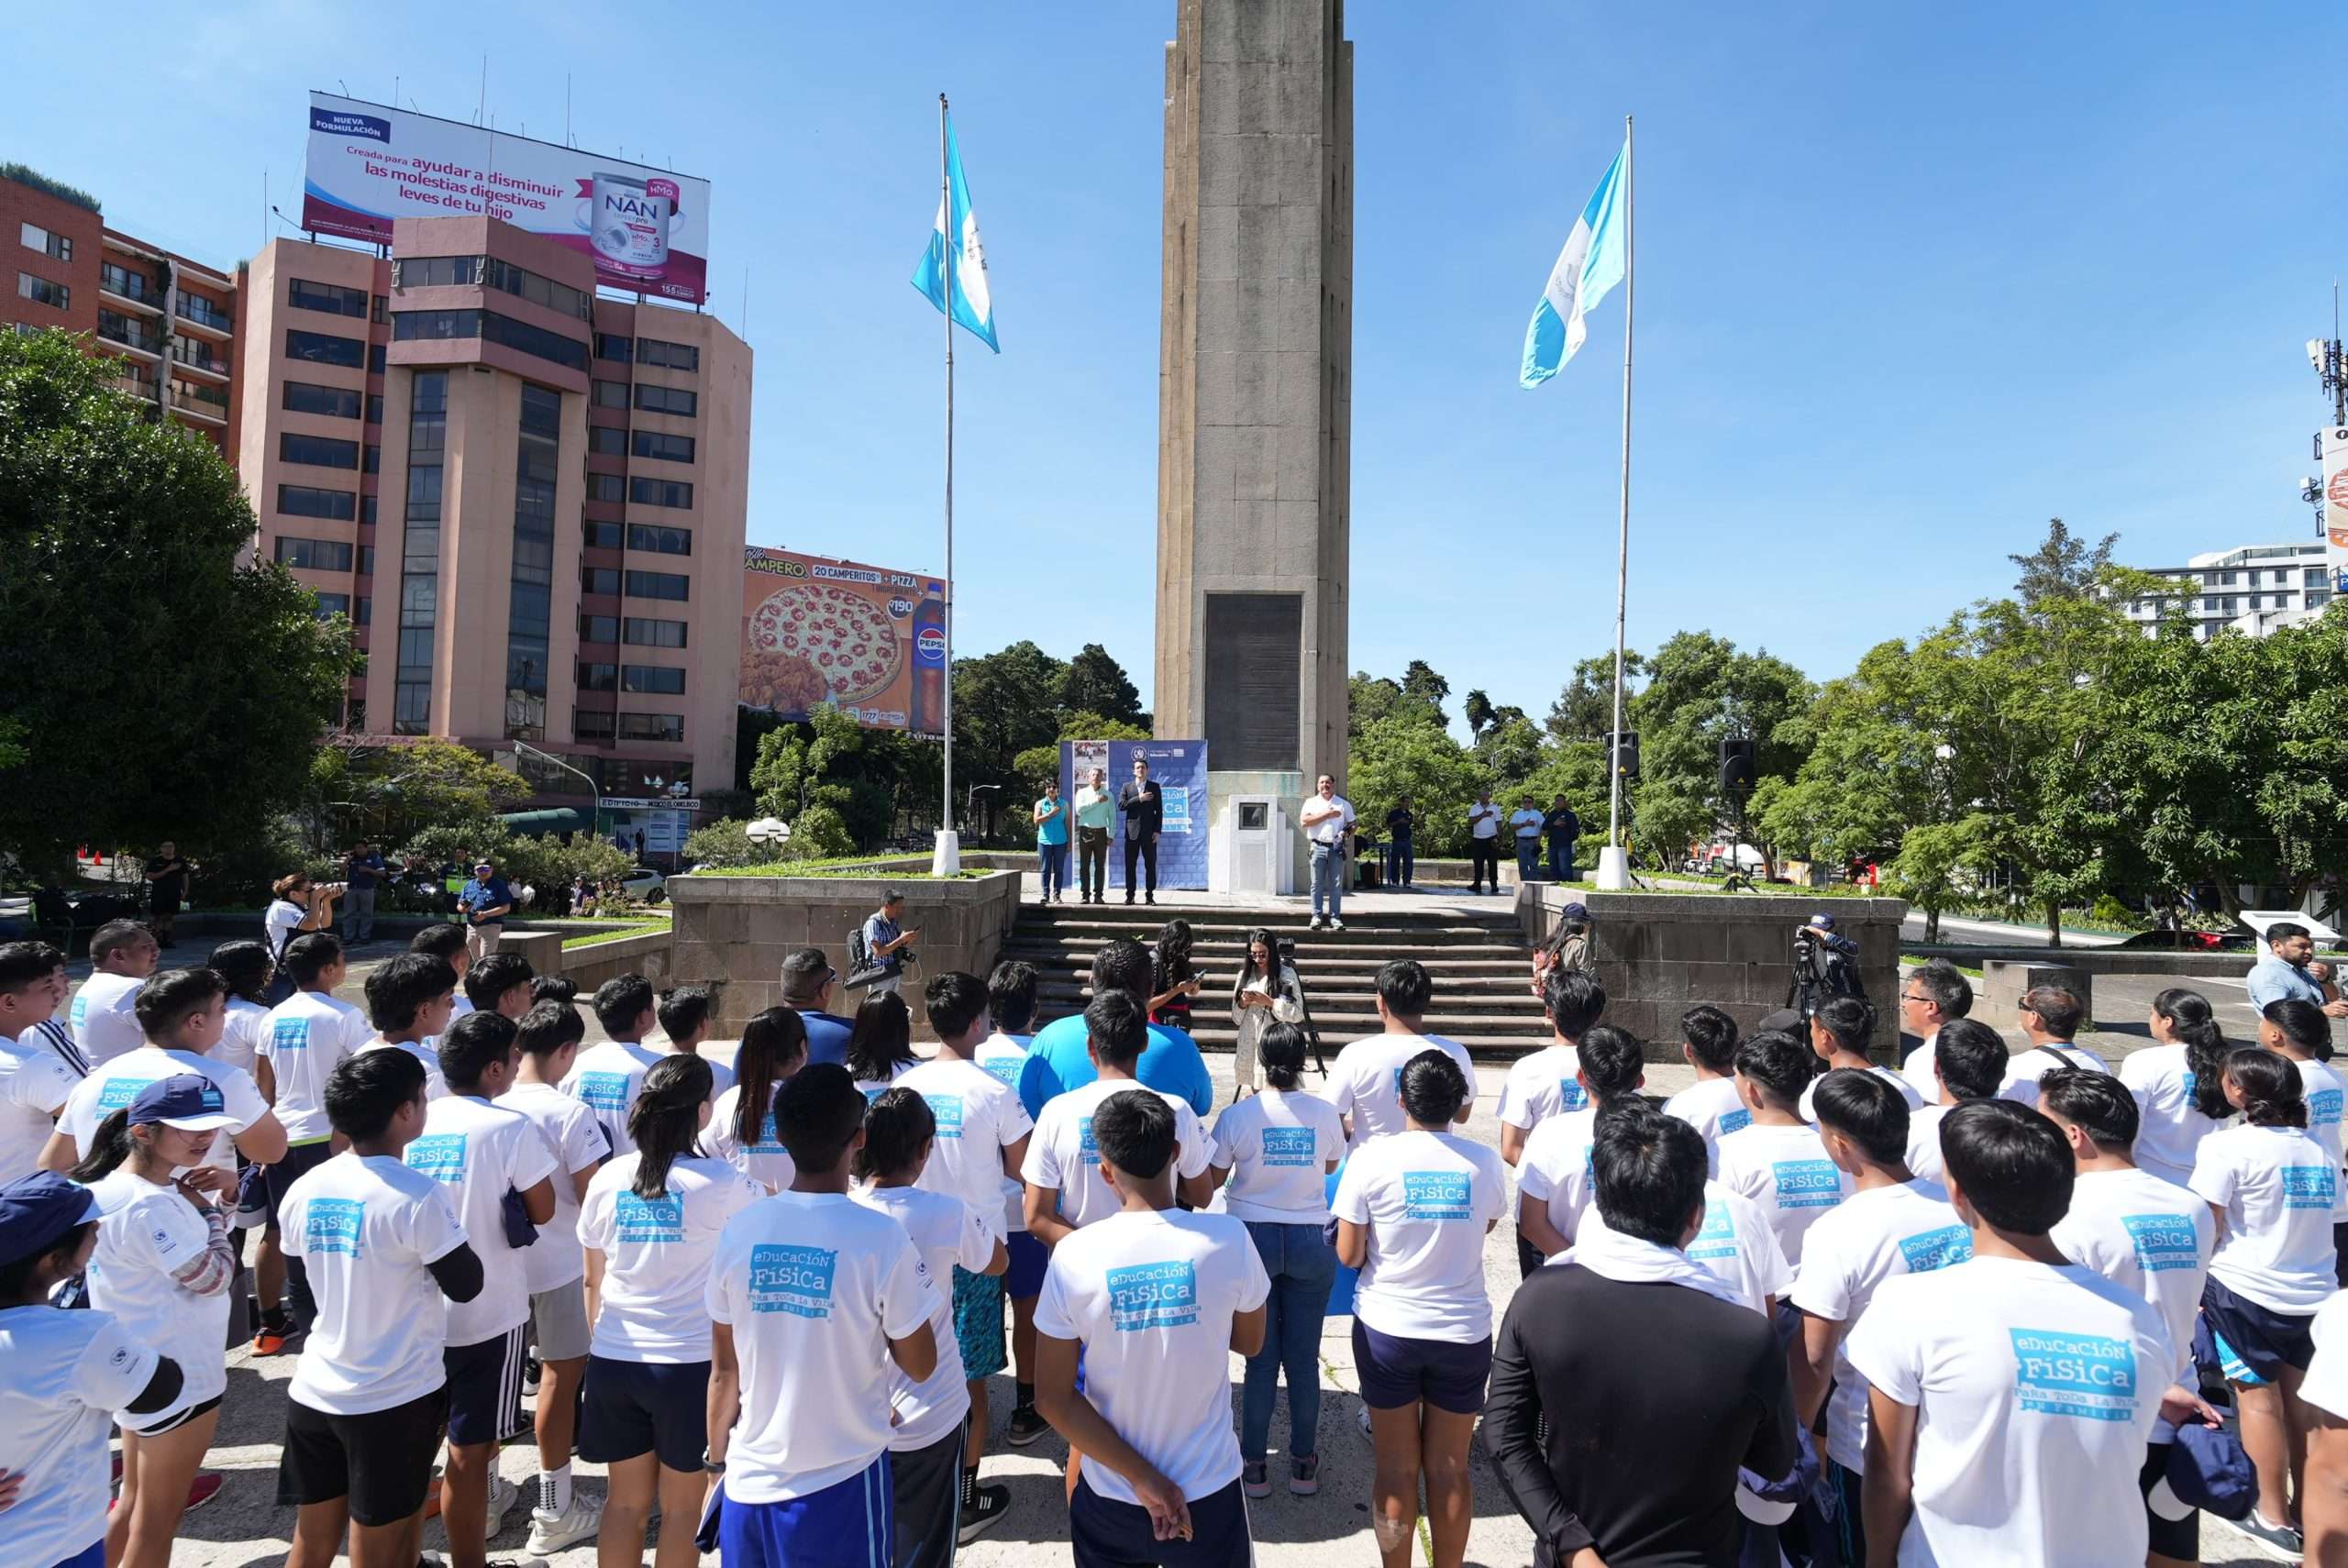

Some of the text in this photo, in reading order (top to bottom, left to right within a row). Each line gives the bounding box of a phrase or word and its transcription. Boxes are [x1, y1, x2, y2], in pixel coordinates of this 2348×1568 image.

[316, 120, 381, 138] FORMULACIÓN
[333, 116, 364, 126] NUEVA
[347, 146, 564, 198] Creada para ayudar a disminuir
[365, 161, 546, 211] las molestias digestivas
[399, 185, 514, 221] leves de tu hijo
[605, 194, 658, 219] NAN
[653, 237, 660, 248] 3
[744, 558, 805, 578] AMPERO
[814, 566, 826, 577] 20
[891, 574, 918, 588] PIZZA
[935, 1107, 959, 1121] iCa
